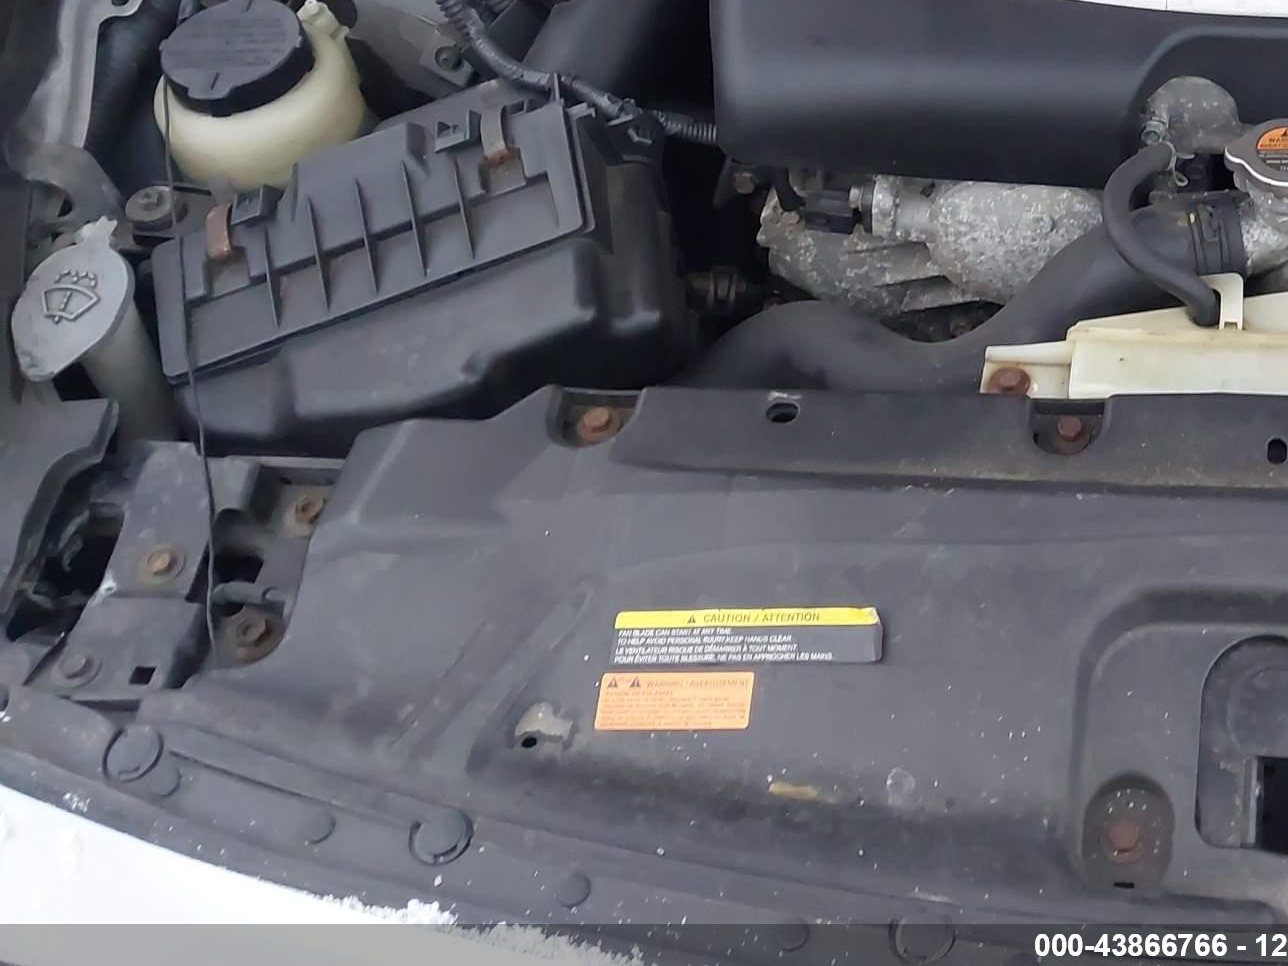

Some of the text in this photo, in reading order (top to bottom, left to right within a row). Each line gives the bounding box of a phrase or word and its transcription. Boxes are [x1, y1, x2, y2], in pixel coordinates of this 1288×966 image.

[703, 614, 751, 624] CAUTION
[761, 612, 821, 623] ATTENTION
[655, 628, 671, 636] CAN
[671, 628, 692, 636] START
[617, 637, 627, 646] TO
[627, 637, 646, 645] HELP
[645, 637, 667, 645] AVOID
[748, 644, 766, 652] TOUT
